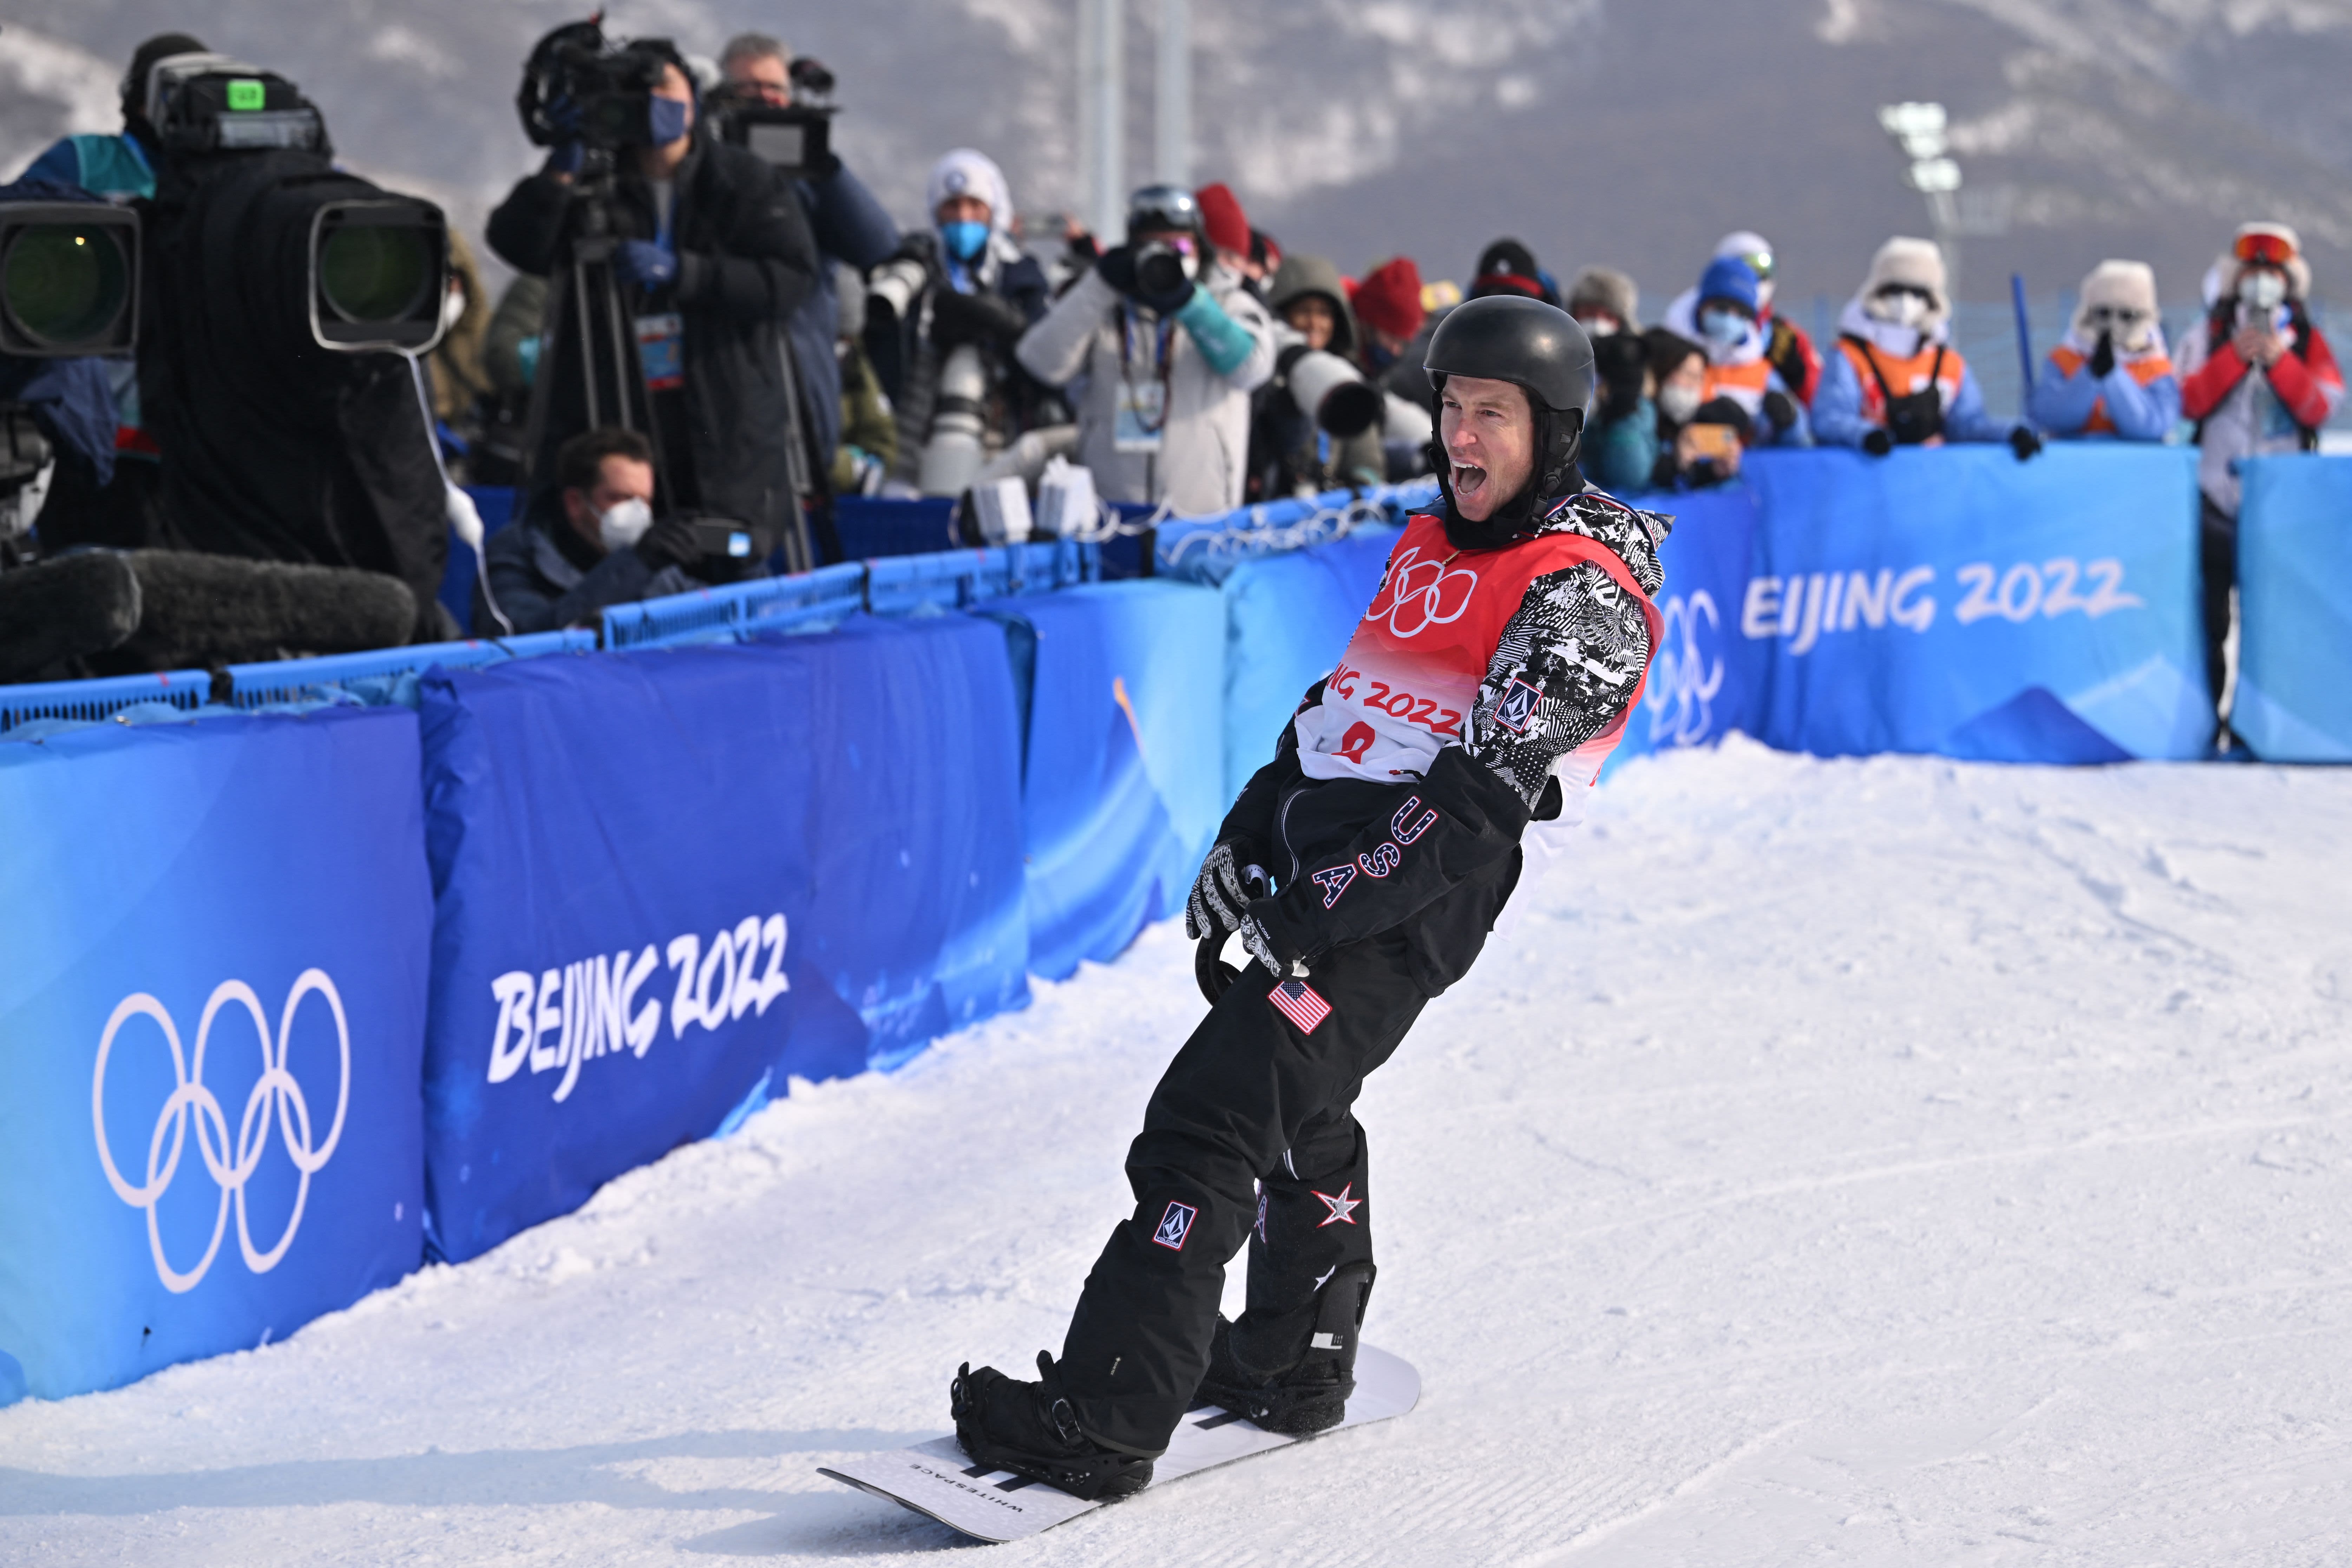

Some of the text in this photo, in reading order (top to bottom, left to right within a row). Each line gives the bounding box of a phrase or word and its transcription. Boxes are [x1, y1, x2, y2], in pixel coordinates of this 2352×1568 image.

[1955, 556, 2145, 625] 2022
[1326, 662, 1461, 737] NG 2022
[1498, 713, 1521, 729] VOLCOM
[1311, 795, 1439, 910] USA
[1256, 918, 1271, 940] VOLCOM
[487, 912, 790, 1103] BEIJING 2022
[1157, 1235, 1179, 1247] VOLCOM
[909, 1464, 1023, 1513] WHITESPACE
